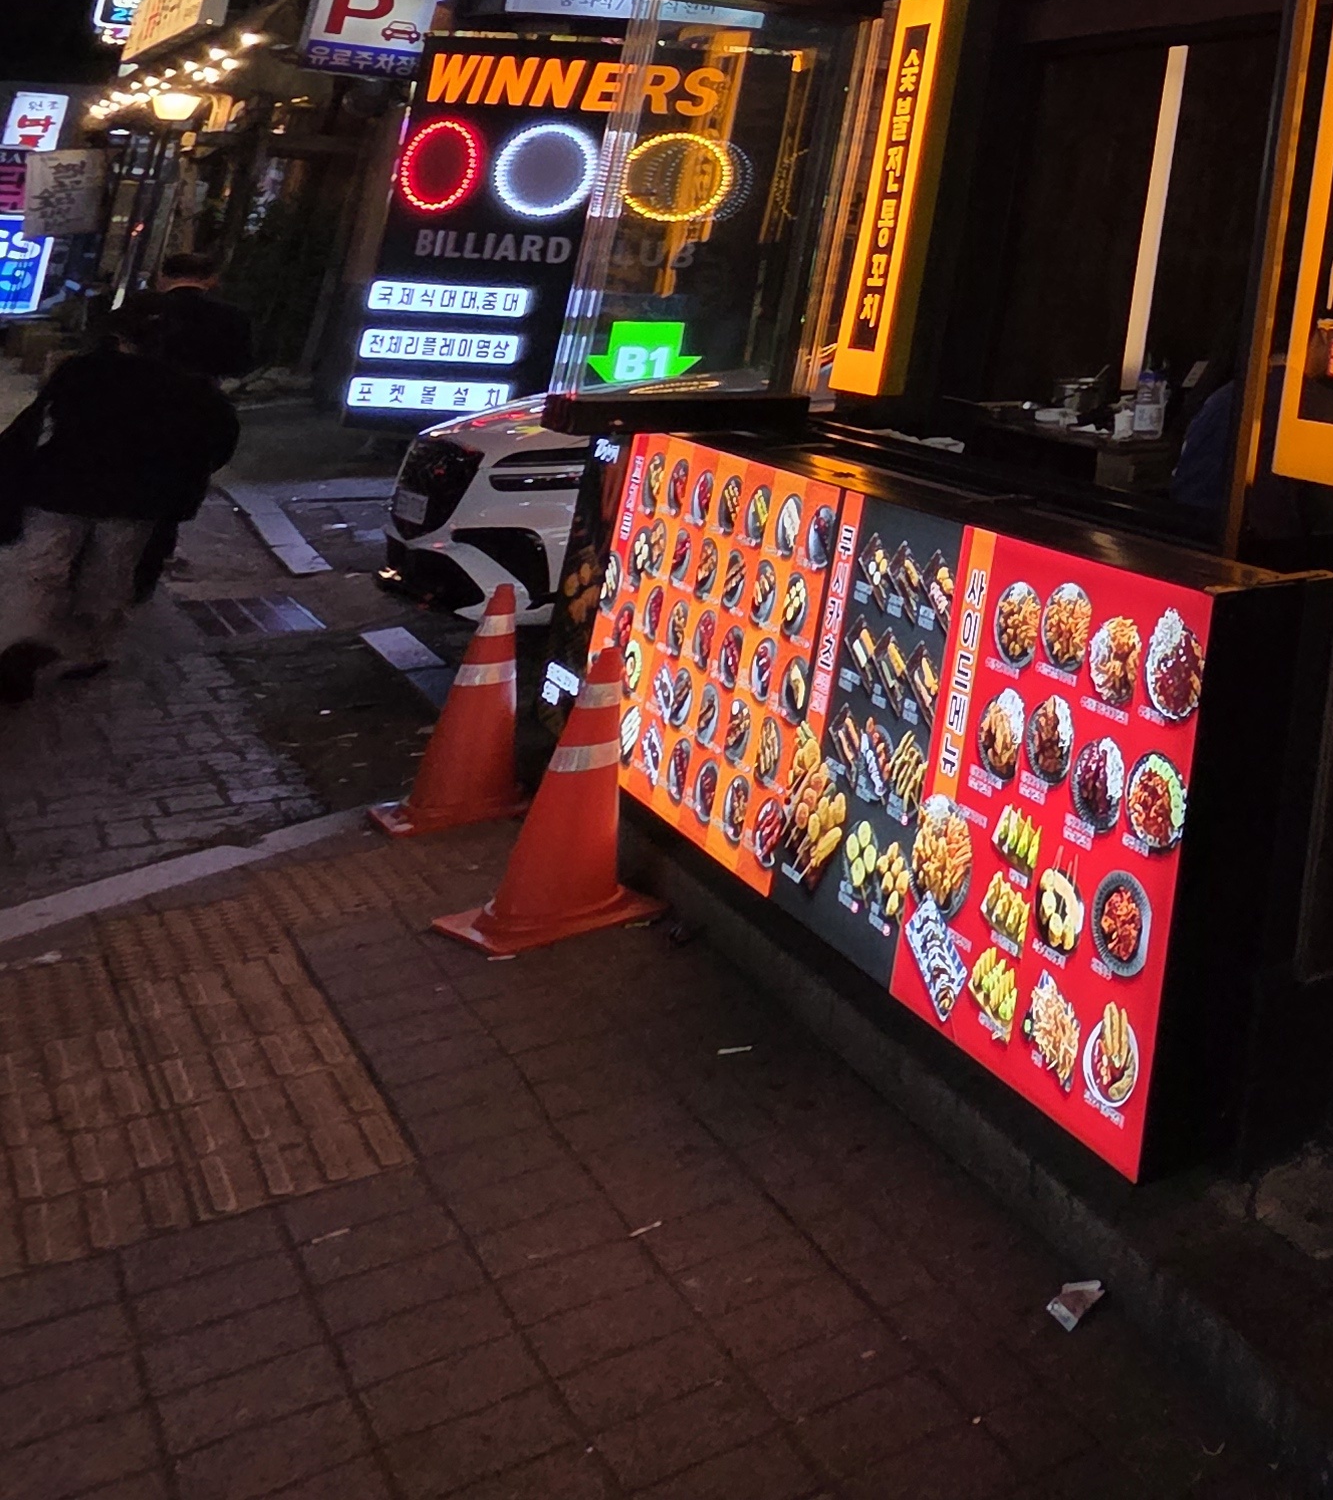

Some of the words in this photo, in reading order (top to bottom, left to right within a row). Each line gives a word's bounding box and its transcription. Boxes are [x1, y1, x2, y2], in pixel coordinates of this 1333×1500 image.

[308, 45, 416, 76] 유료주차장
[426, 53, 727, 116] WINNERS
[414, 228, 573, 265] BILLIARD
[369, 333, 511, 360] 전체리플레이영상
[613, 345, 671, 381] B1
[939, 568, 987, 778] 사이드메뉴
